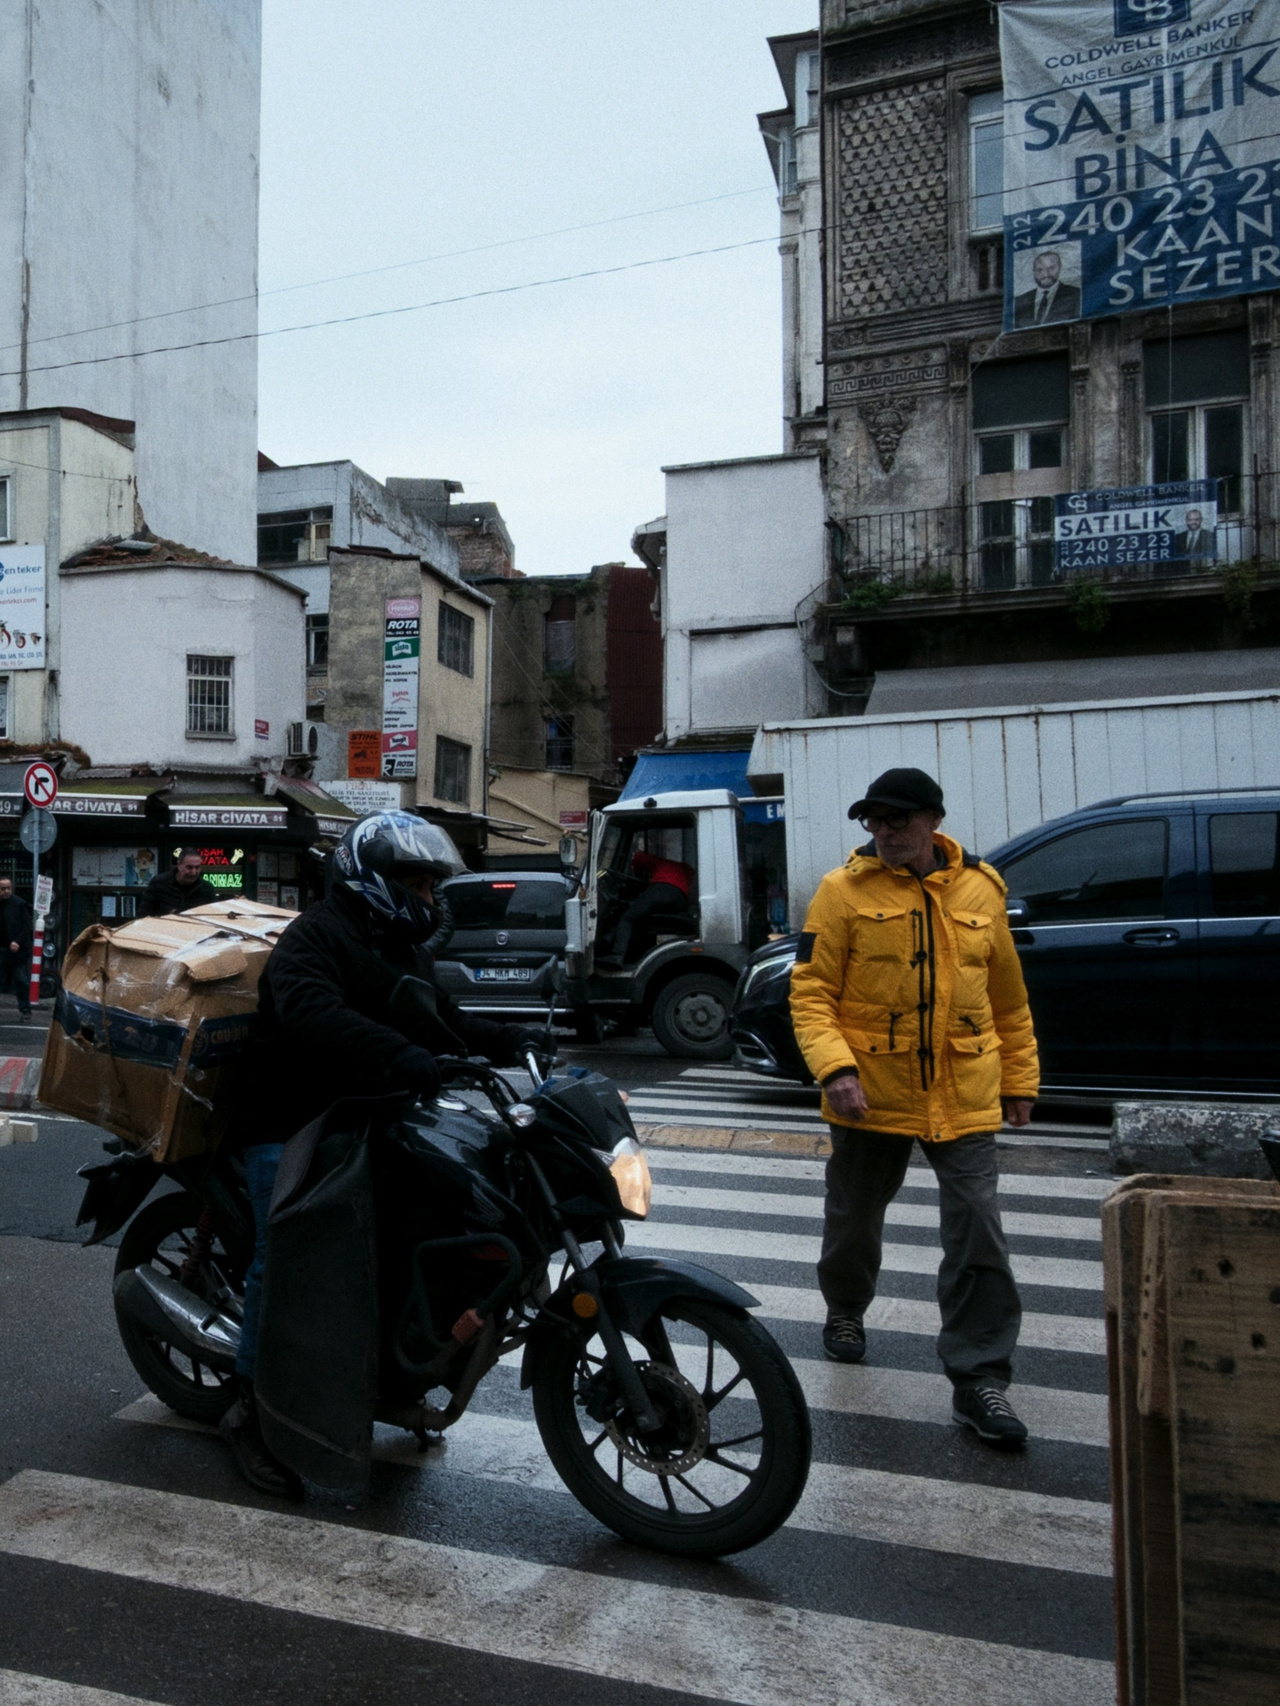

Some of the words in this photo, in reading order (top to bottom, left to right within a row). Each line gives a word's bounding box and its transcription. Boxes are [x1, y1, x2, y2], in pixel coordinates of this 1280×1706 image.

[1045, 34, 1161, 69] COLDWELL
[1166, 9, 1255, 44] BANKER
[1061, 66, 1120, 86] ANGEL
[1024, 47, 1280, 152] SATILIK
[1075, 128, 1235, 201] BİNA
[1036, 196, 1134, 245] 240
[1152, 178, 1216, 224] 23
[1012, 213, 1031, 250] 212
[1116, 204, 1274, 267] KAAN
[1108, 245, 1280, 306] SEZER
[1095, 487, 1156, 501] COLDWELL
[1158, 482, 1205, 494] BANKER
[1109, 502, 1133, 510] ANGEL
[1060, 509, 1173, 537] SATILIK
[1073, 539, 1109, 554] 240
[1118, 536, 1140, 550] 23
[1147, 534, 1171, 548] 23
[1061, 554, 1109, 568] KAAN
[1116, 548, 1171, 563] SEZER
[387, 620, 418, 630] ROTA
[46, 800, 71, 811] SAR
[74, 797, 123, 813] CİVATA
[174, 810, 217, 824] HİSAR
[220, 811, 269, 825] CİVATA
[201, 856, 229, 866] VATA
[203, 873, 242, 888] ANMAZ
